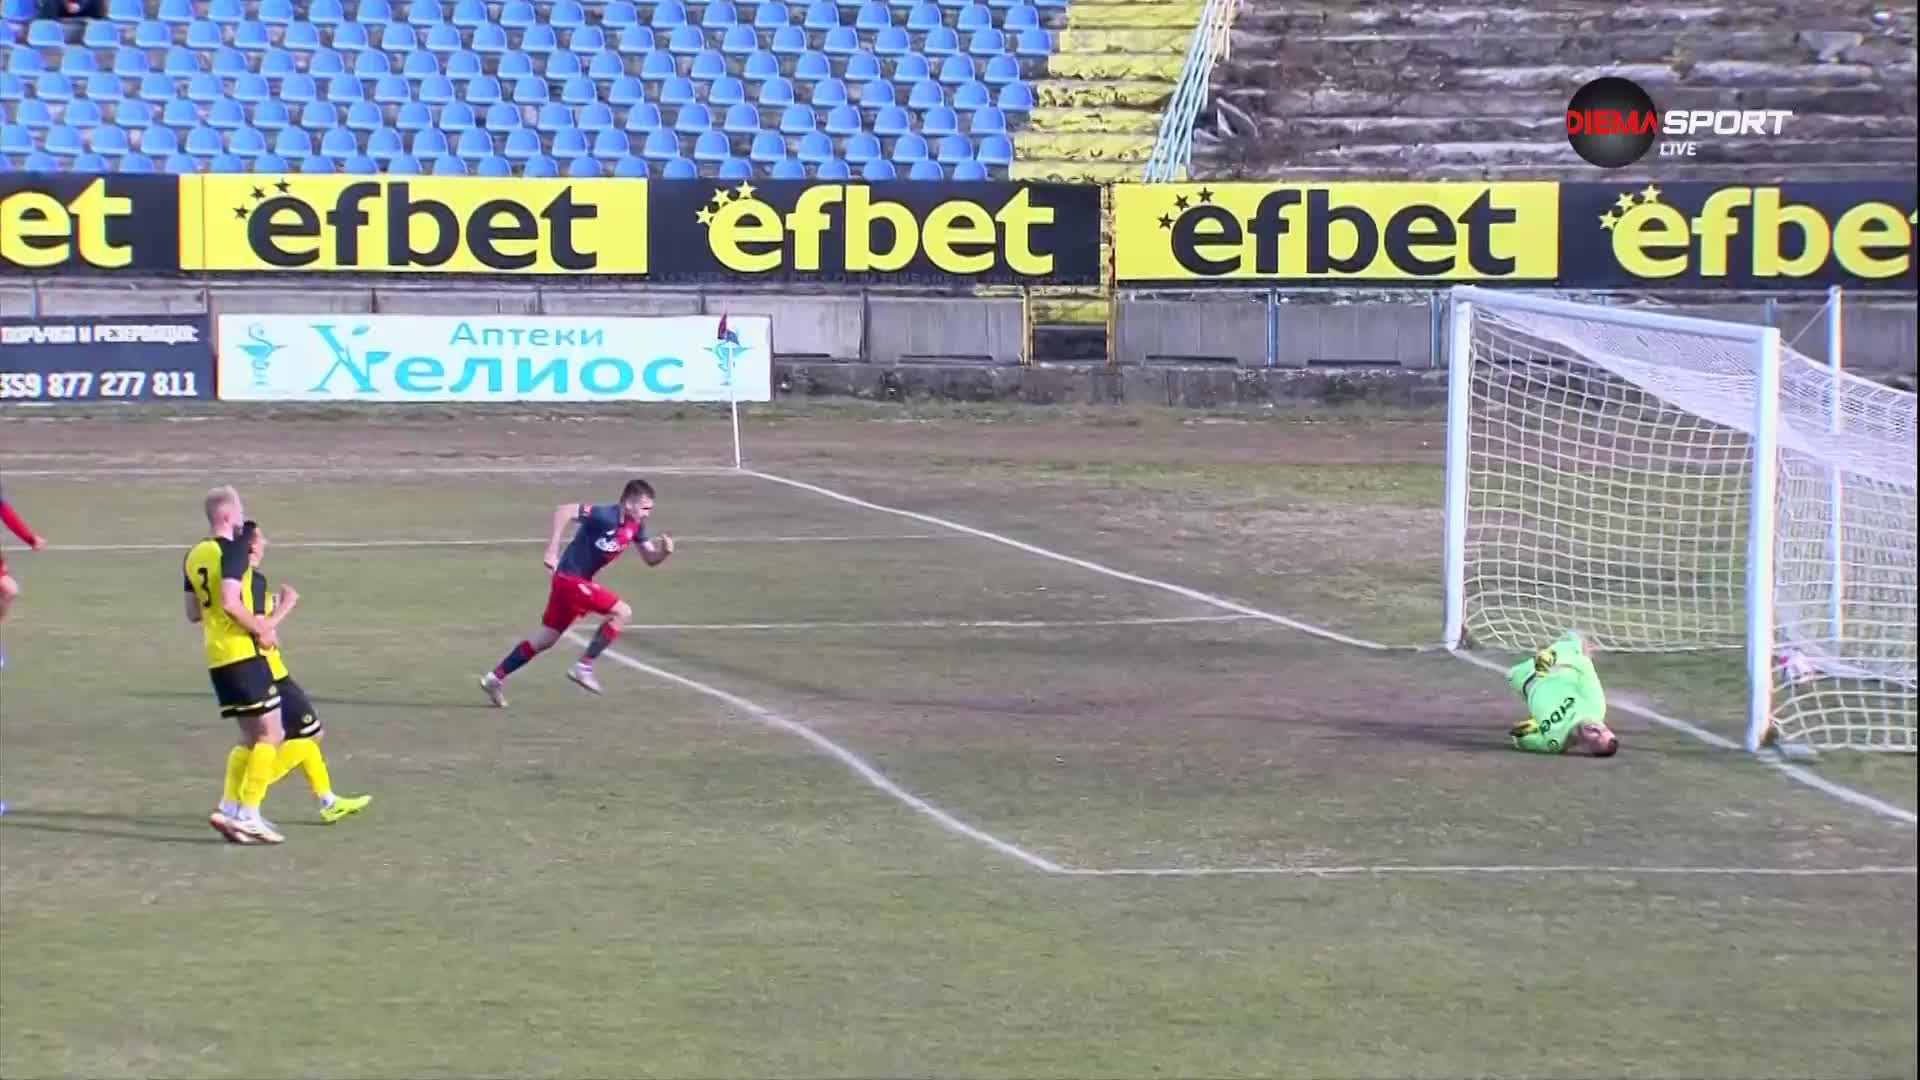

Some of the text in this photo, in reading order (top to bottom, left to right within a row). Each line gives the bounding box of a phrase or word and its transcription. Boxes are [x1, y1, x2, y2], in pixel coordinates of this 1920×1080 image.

[247, 181, 598, 270] efbet
[708, 184, 1055, 277] efbet
[1170, 188, 1517, 277] efbet
[1611, 186, 1918, 279] efbe
[307, 324, 685, 394] Хелиос
[449, 322, 604, 346] Аптеки
[48, 371, 93, 397] 877
[100, 371, 146, 397] 277
[152, 371, 200, 397] 811
[197, 566, 213, 609] 3
